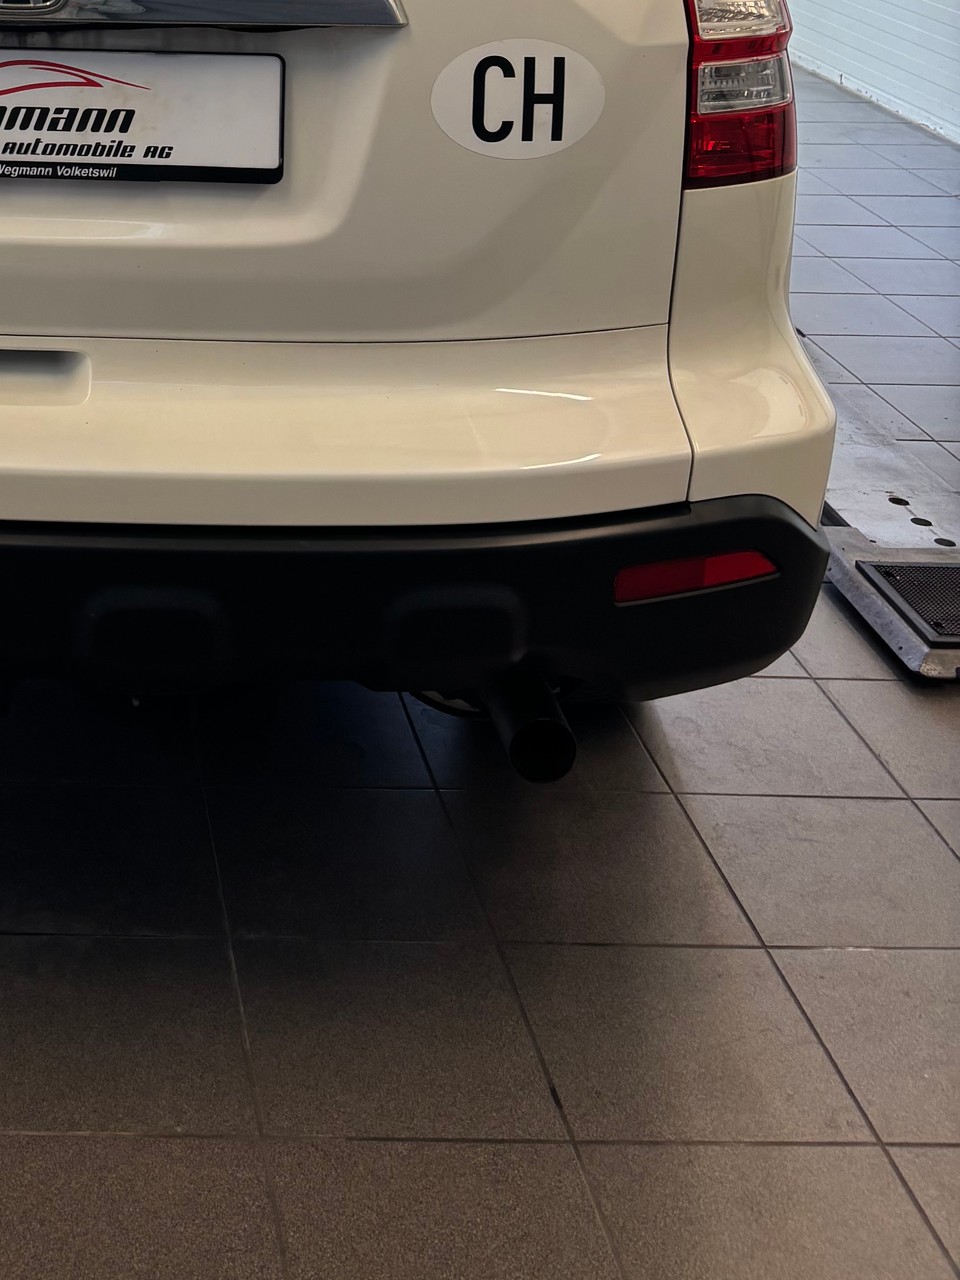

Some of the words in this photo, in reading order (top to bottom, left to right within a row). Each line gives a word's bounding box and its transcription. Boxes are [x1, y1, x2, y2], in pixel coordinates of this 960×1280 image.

[472, 55, 566, 143] CH
[143, 145, 174, 159] AG
[56, 165, 117, 179] Volketswil
